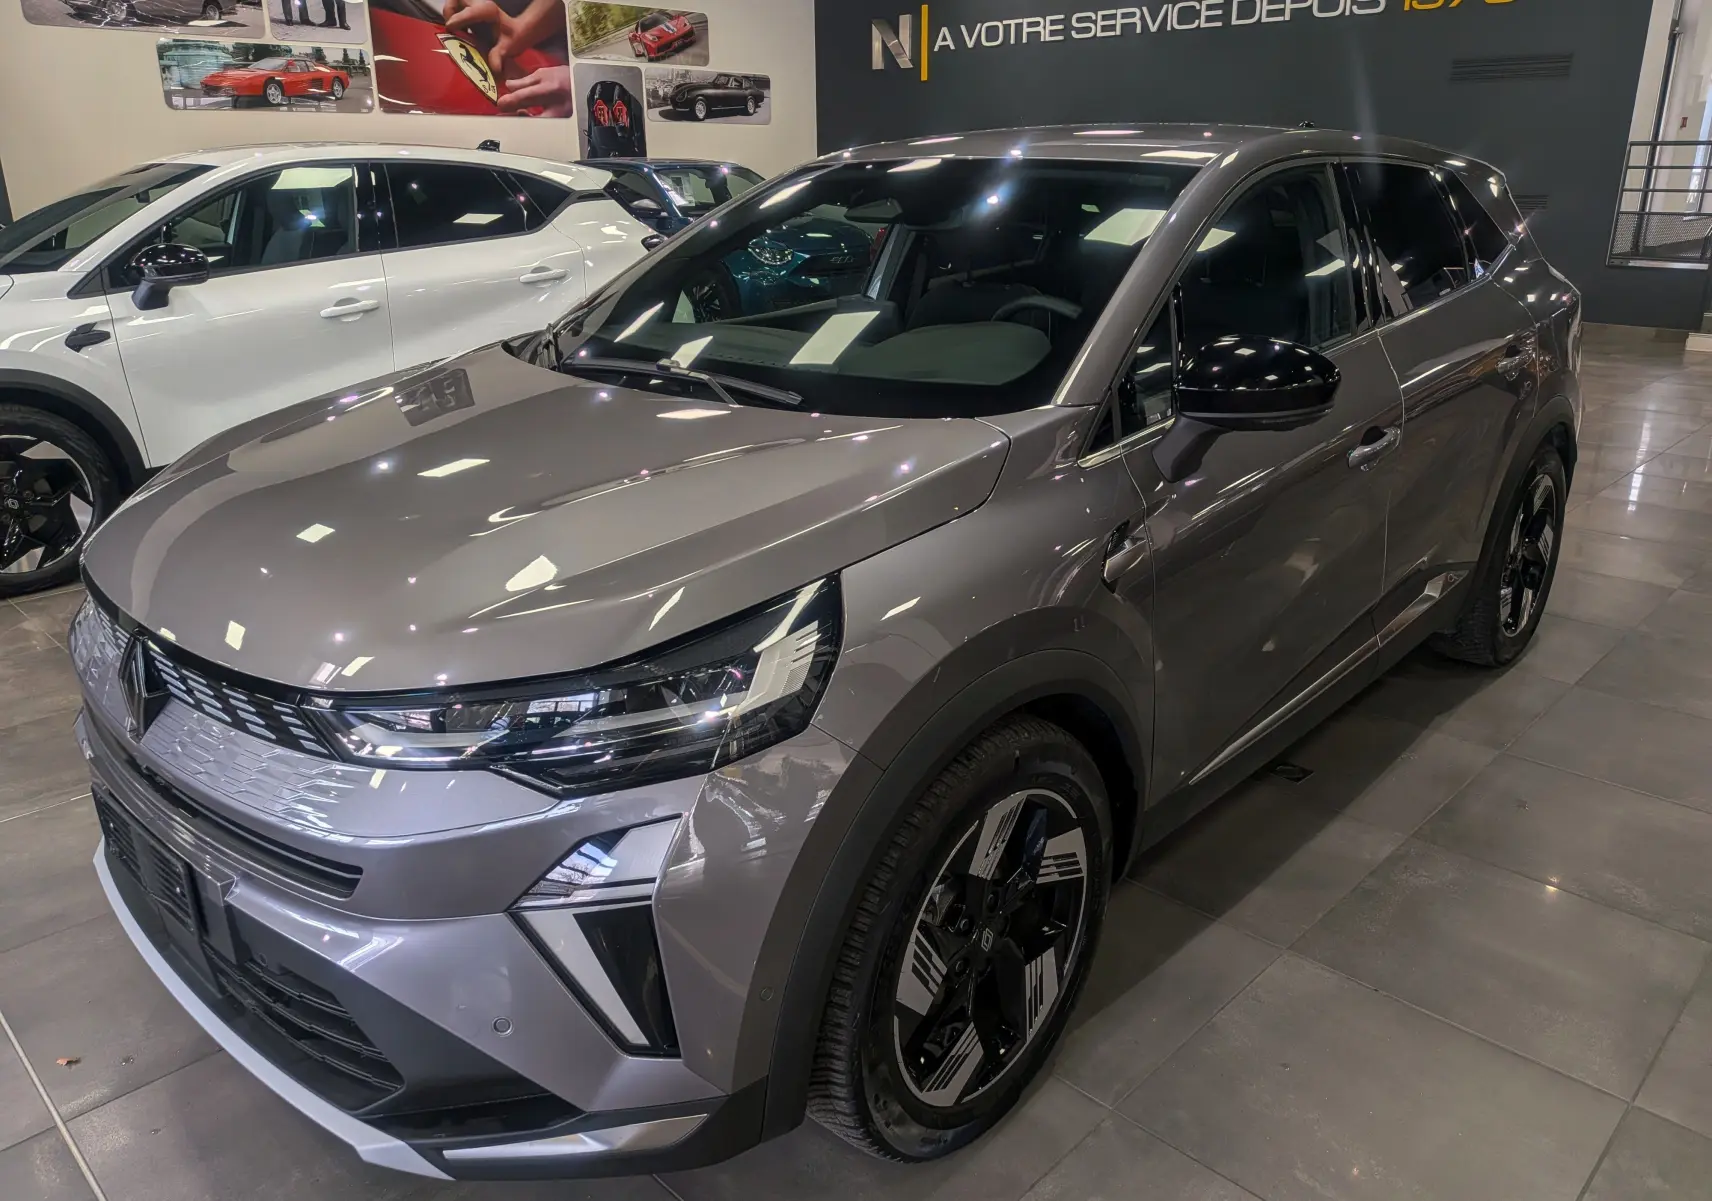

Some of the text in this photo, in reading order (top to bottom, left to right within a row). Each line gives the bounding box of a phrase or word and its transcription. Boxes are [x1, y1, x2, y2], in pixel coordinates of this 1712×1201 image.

[872, 14, 913, 69] N
[934, 26, 955, 51] A
[960, 14, 1065, 48] VOTRE
[1071, 0, 1223, 39] SERVICE
